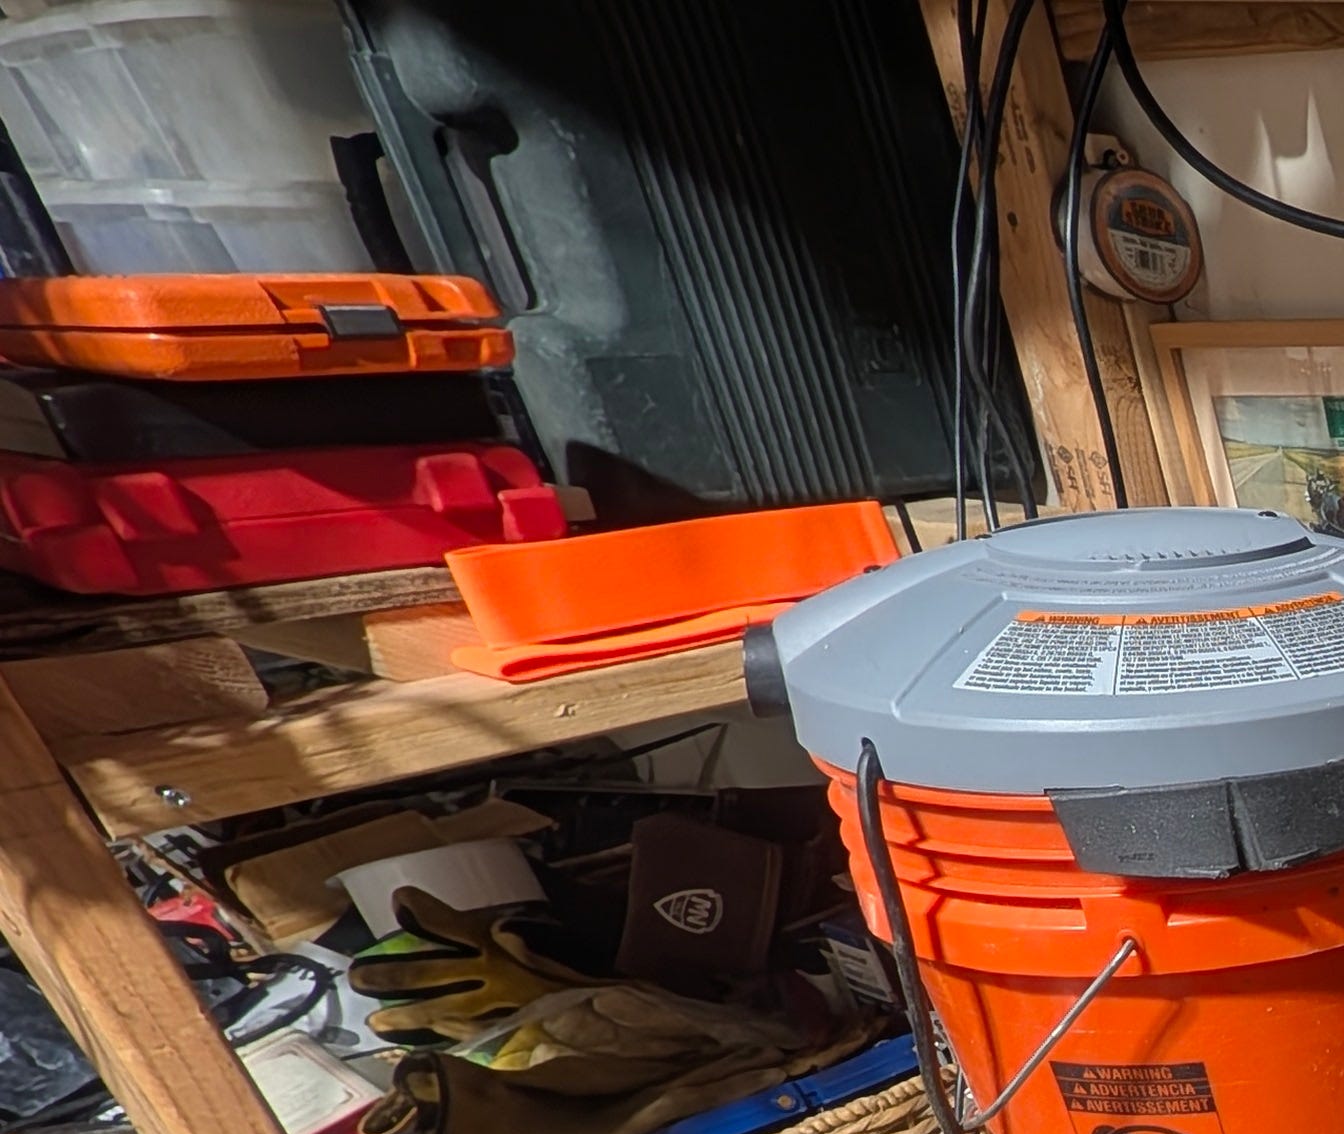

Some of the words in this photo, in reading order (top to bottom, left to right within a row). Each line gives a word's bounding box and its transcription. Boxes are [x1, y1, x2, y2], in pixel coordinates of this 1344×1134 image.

[1097, 1066, 1173, 1080] WARNING
[1090, 1082, 1196, 1096] ADVERTENCIA
[1086, 1098, 1210, 1114] AVERTISSEMENT
